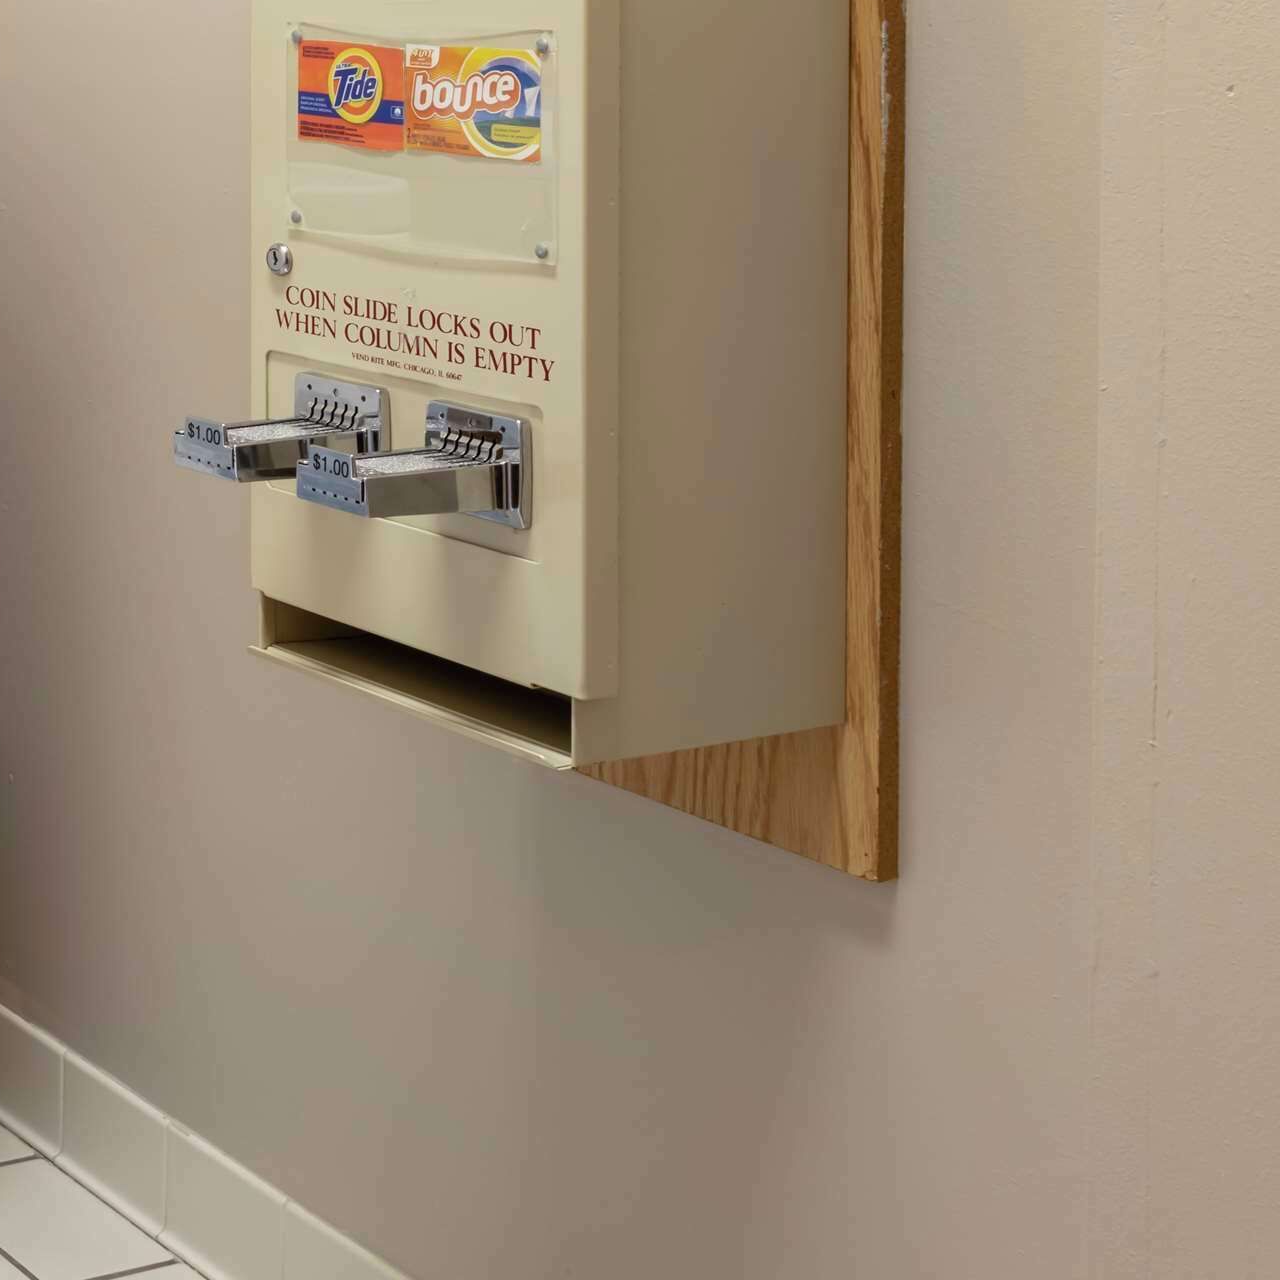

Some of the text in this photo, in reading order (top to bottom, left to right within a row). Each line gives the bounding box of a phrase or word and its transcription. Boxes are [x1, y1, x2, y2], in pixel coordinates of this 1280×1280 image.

[333, 66, 378, 109] Tide
[413, 72, 515, 113] bounce
[285, 284, 542, 351] COIN SLIDE LOCKS OUT
[275, 307, 555, 382] WHEN COLUMN IS EMPTY
[351, 351, 370, 362] VEND
[370, 356, 385, 366] RITE
[187, 421, 222, 446] $1.00
[312, 453, 350, 479] $1.00
